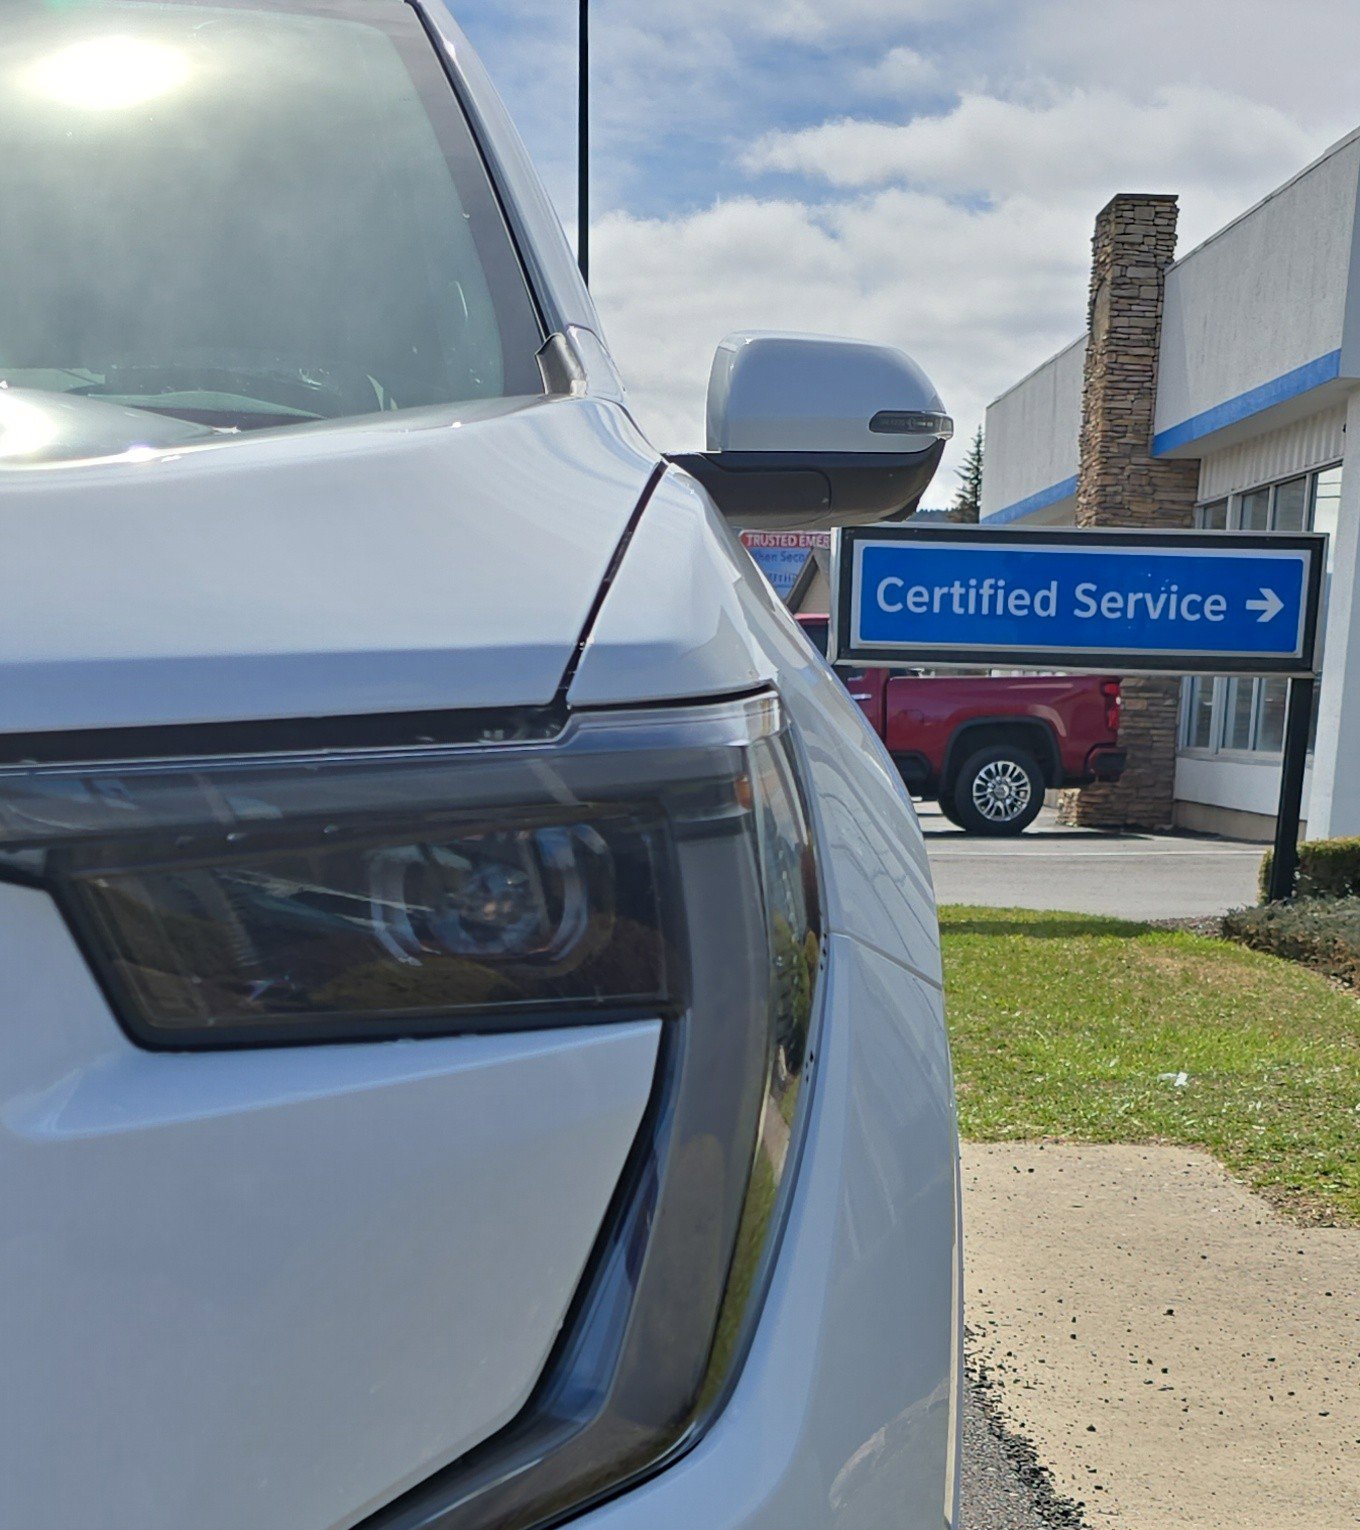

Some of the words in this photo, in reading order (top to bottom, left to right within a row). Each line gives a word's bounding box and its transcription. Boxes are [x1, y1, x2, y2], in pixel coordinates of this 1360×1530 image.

[746, 534, 797, 547] TRUSTED
[876, 576, 1058, 617] Certified
[1073, 582, 1228, 622] Service
